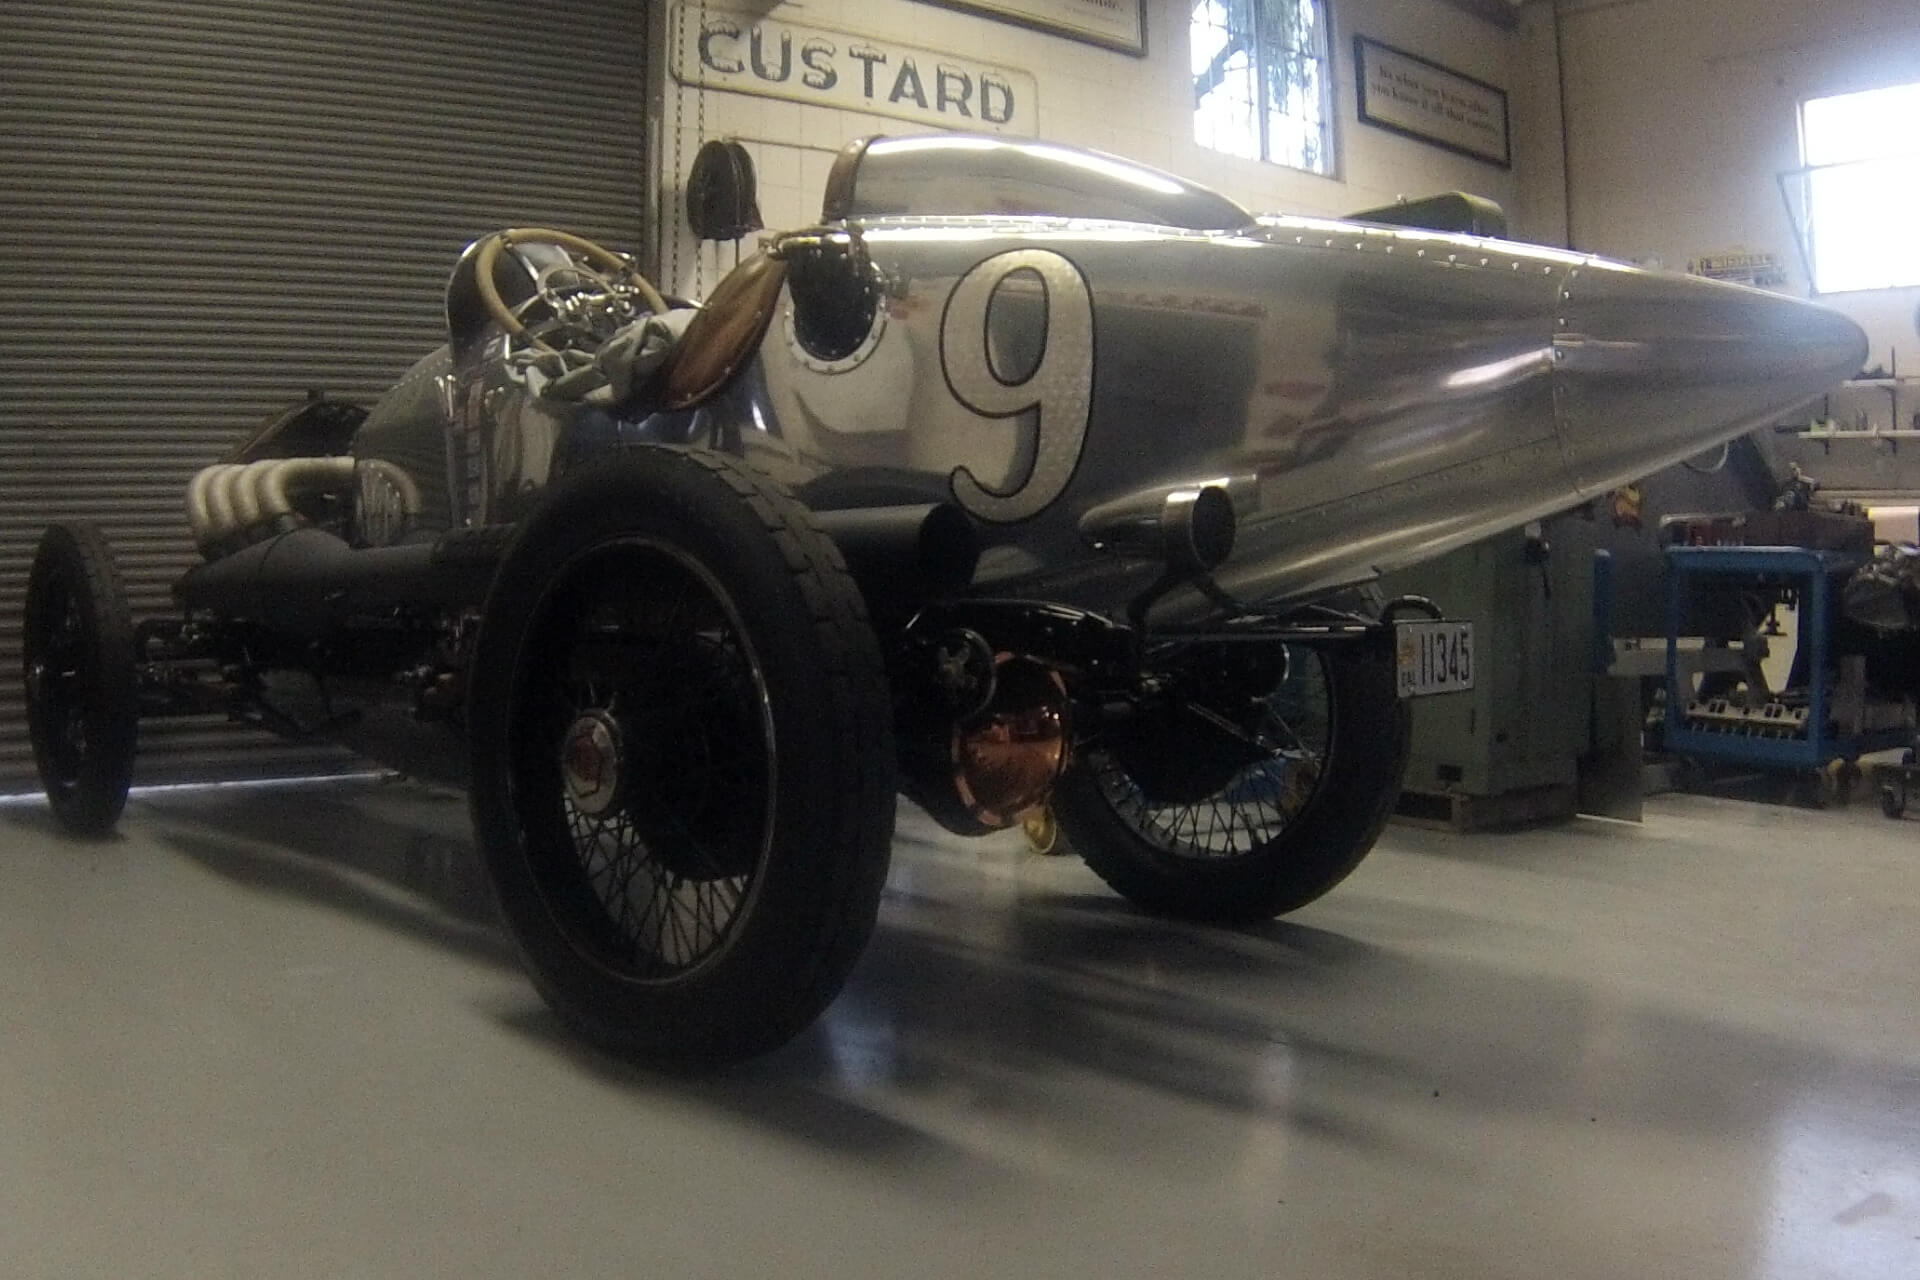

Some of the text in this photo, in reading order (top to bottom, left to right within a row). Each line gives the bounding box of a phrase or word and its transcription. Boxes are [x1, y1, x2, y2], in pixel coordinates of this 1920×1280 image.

[697, 18, 1015, 125] CUSTARD
[938, 247, 1096, 523] 9
[1420, 631, 1470, 685] 11345
